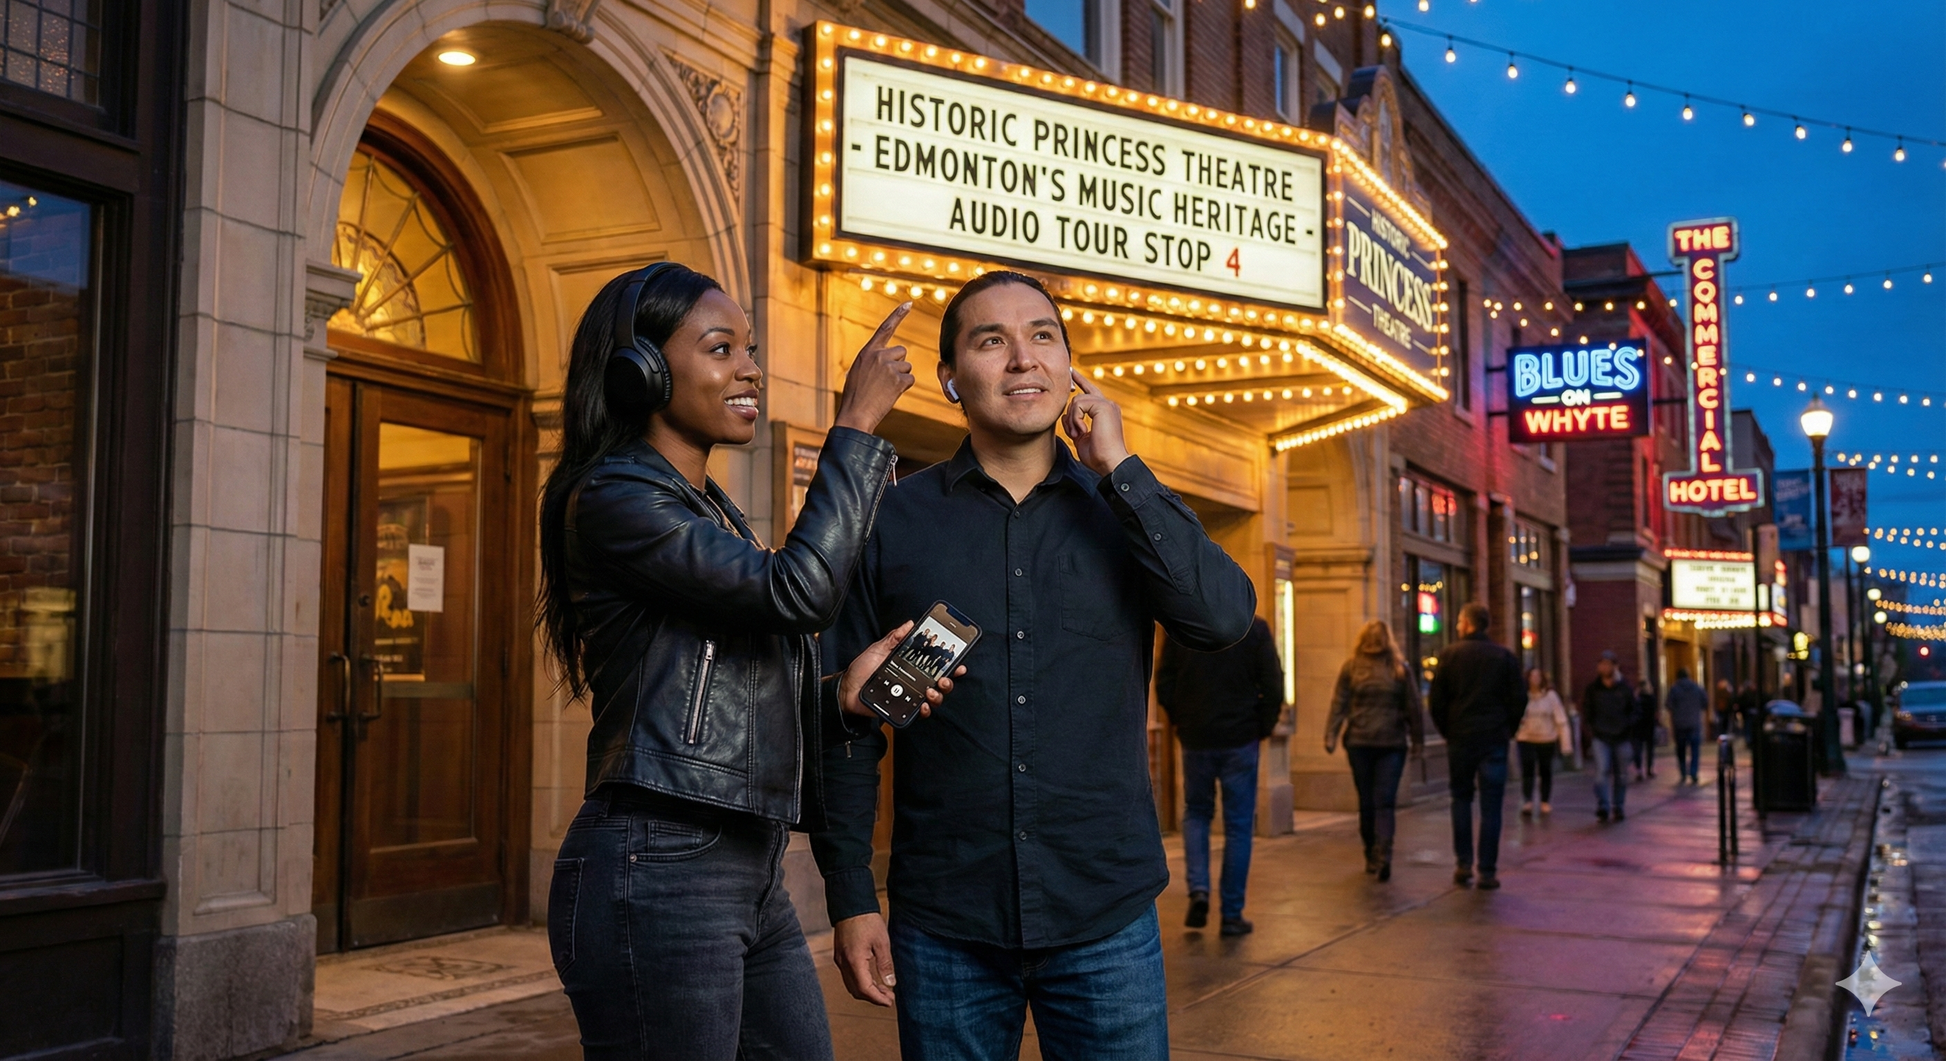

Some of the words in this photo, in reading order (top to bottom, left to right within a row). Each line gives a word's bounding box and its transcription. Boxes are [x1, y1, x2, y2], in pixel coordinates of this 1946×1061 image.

[877, 86, 1017, 147] HISTORIC
[1034, 119, 1165, 176] PRINCESS
[1182, 149, 1294, 202] THEATRE
[875, 134, 1066, 202] EDMONTON'S
[1079, 173, 1162, 220] MUSIC
[1174, 192, 1296, 245] HERITAGE
[950, 197, 1040, 243] AUDIO
[1056, 215, 1129, 259] TOUR
[1144, 231, 1211, 272] STOP
[1225, 247, 1241, 278] 4
[1371, 208, 1411, 260] HISTORIC
[1674, 225, 1731, 252] THE
[1346, 220, 1434, 333] PRINCESS
[1371, 302, 1413, 350] THEATRE
[1514, 346, 1640, 398] BLUES
[1692, 258, 1722, 473] COMMERCIAL
[1525, 405, 1631, 434] WHYTE
[1560, 388, 1592, 407] ON
[1669, 477, 1757, 503] HOTEL
